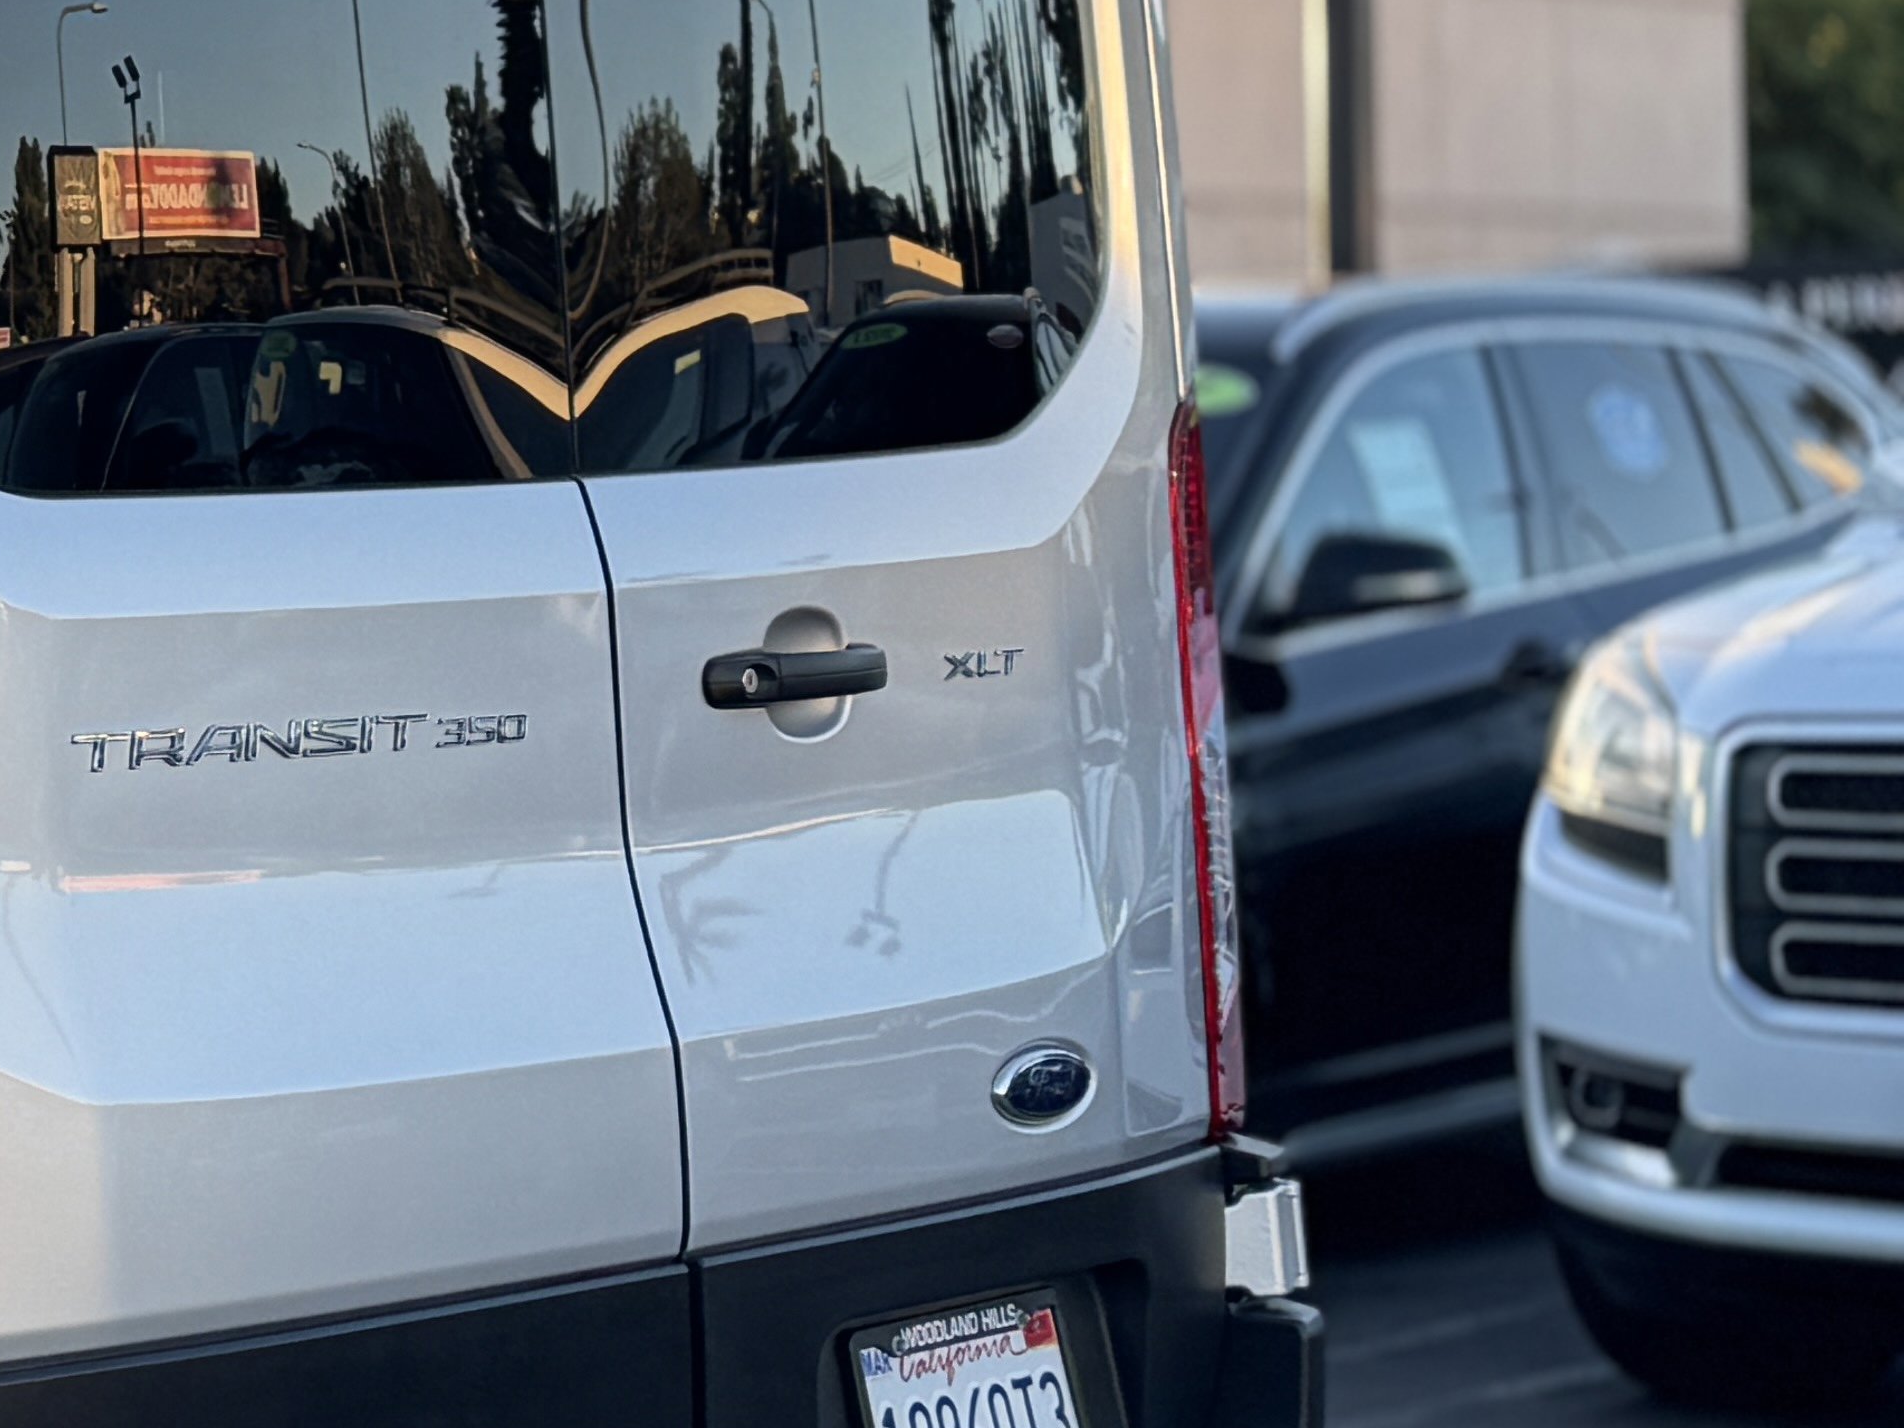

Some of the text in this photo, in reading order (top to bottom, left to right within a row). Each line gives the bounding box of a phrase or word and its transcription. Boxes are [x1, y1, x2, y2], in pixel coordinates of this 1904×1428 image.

[943, 647, 1024, 681] XLT
[70, 713, 529, 773] TRANSIT 350
[900, 1312, 978, 1348] WOODLAND
[980, 1303, 1017, 1331] HILLS
[899, 1334, 1029, 1387] California
